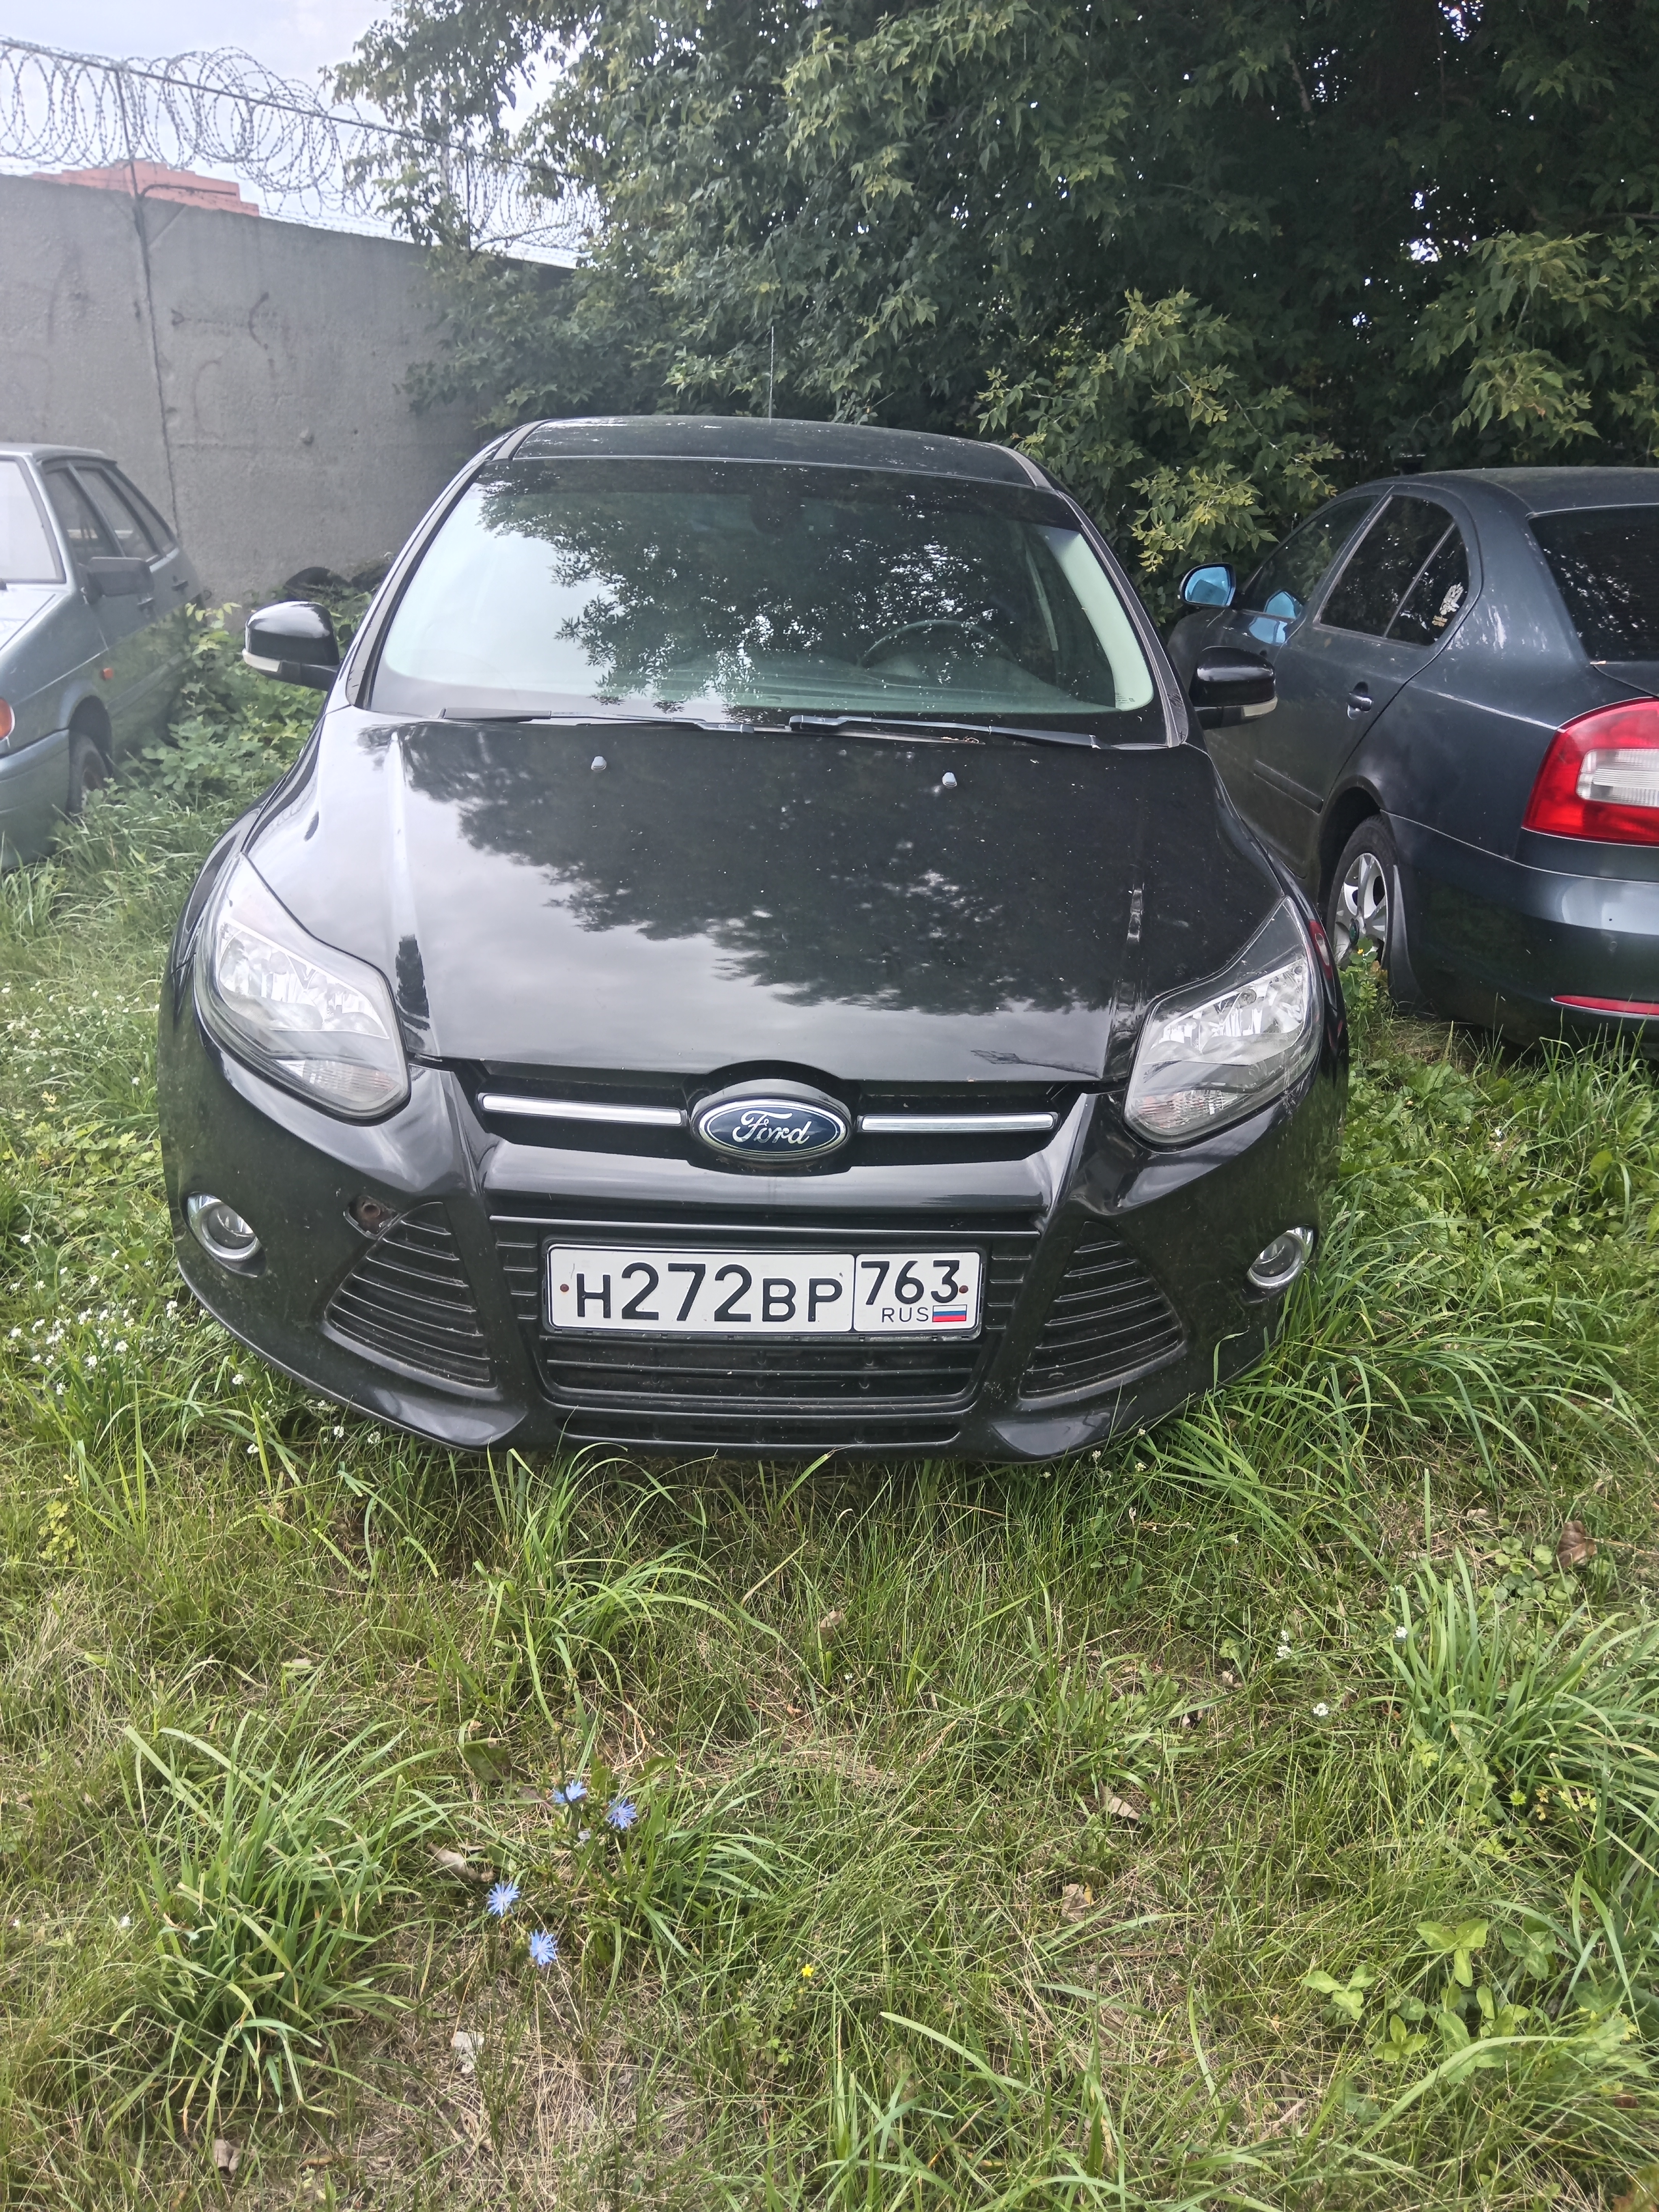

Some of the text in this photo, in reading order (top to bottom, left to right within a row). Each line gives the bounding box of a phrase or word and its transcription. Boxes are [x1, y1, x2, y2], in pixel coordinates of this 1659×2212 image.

[732, 1110, 812, 1145] Ford
[860, 1260, 960, 1305] 763
[881, 1307, 929, 1323] RUS
